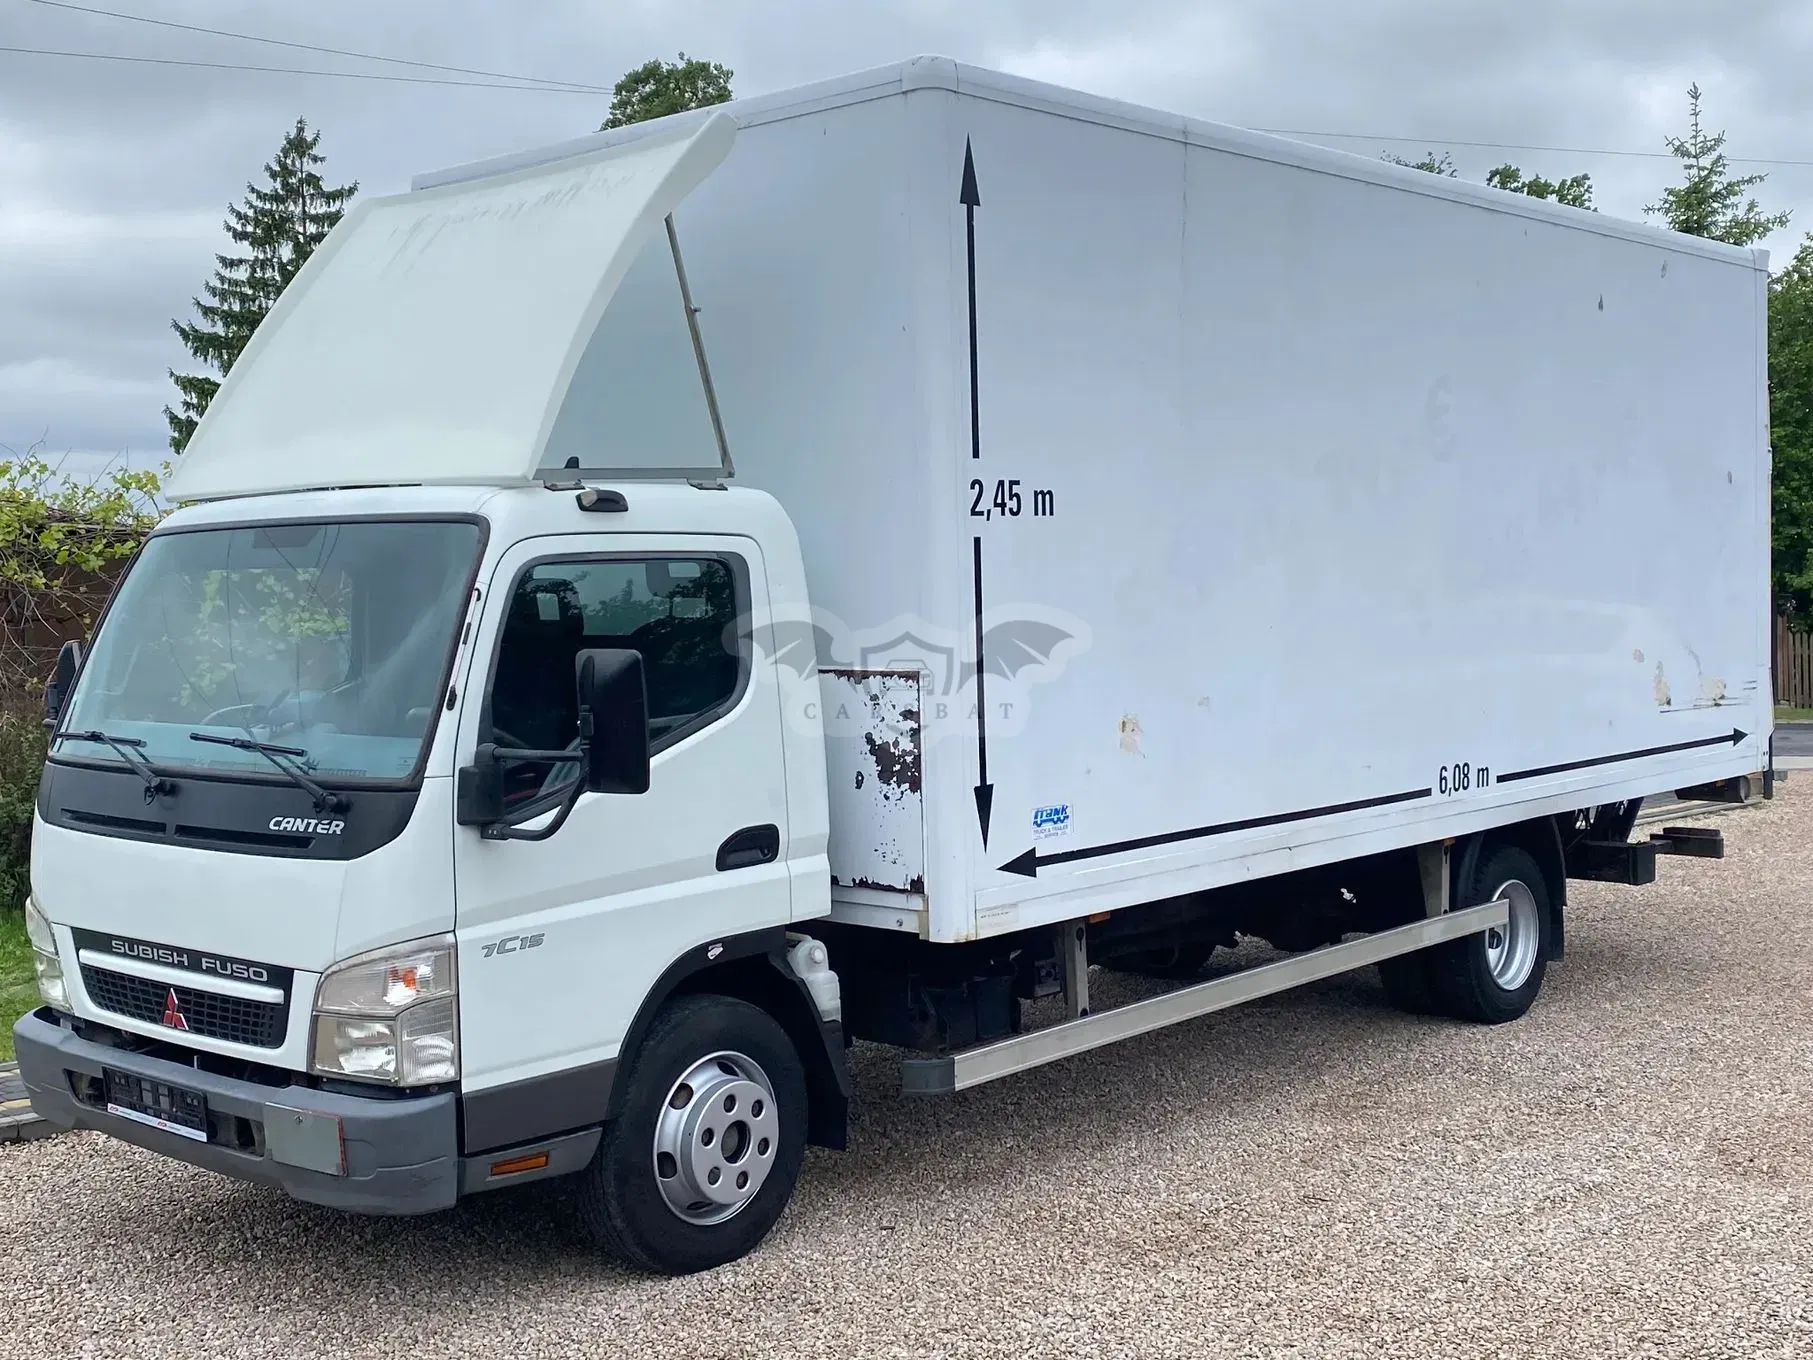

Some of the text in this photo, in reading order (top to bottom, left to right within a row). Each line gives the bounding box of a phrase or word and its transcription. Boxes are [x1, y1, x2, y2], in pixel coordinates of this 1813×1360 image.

[970, 478, 1054, 521] 2,45 m
[1439, 762, 1490, 797] 6,08 m
[268, 816, 345, 835] CANTER
[111, 939, 268, 982] SUBISH FUSO
[481, 932, 546, 958] 7C15
